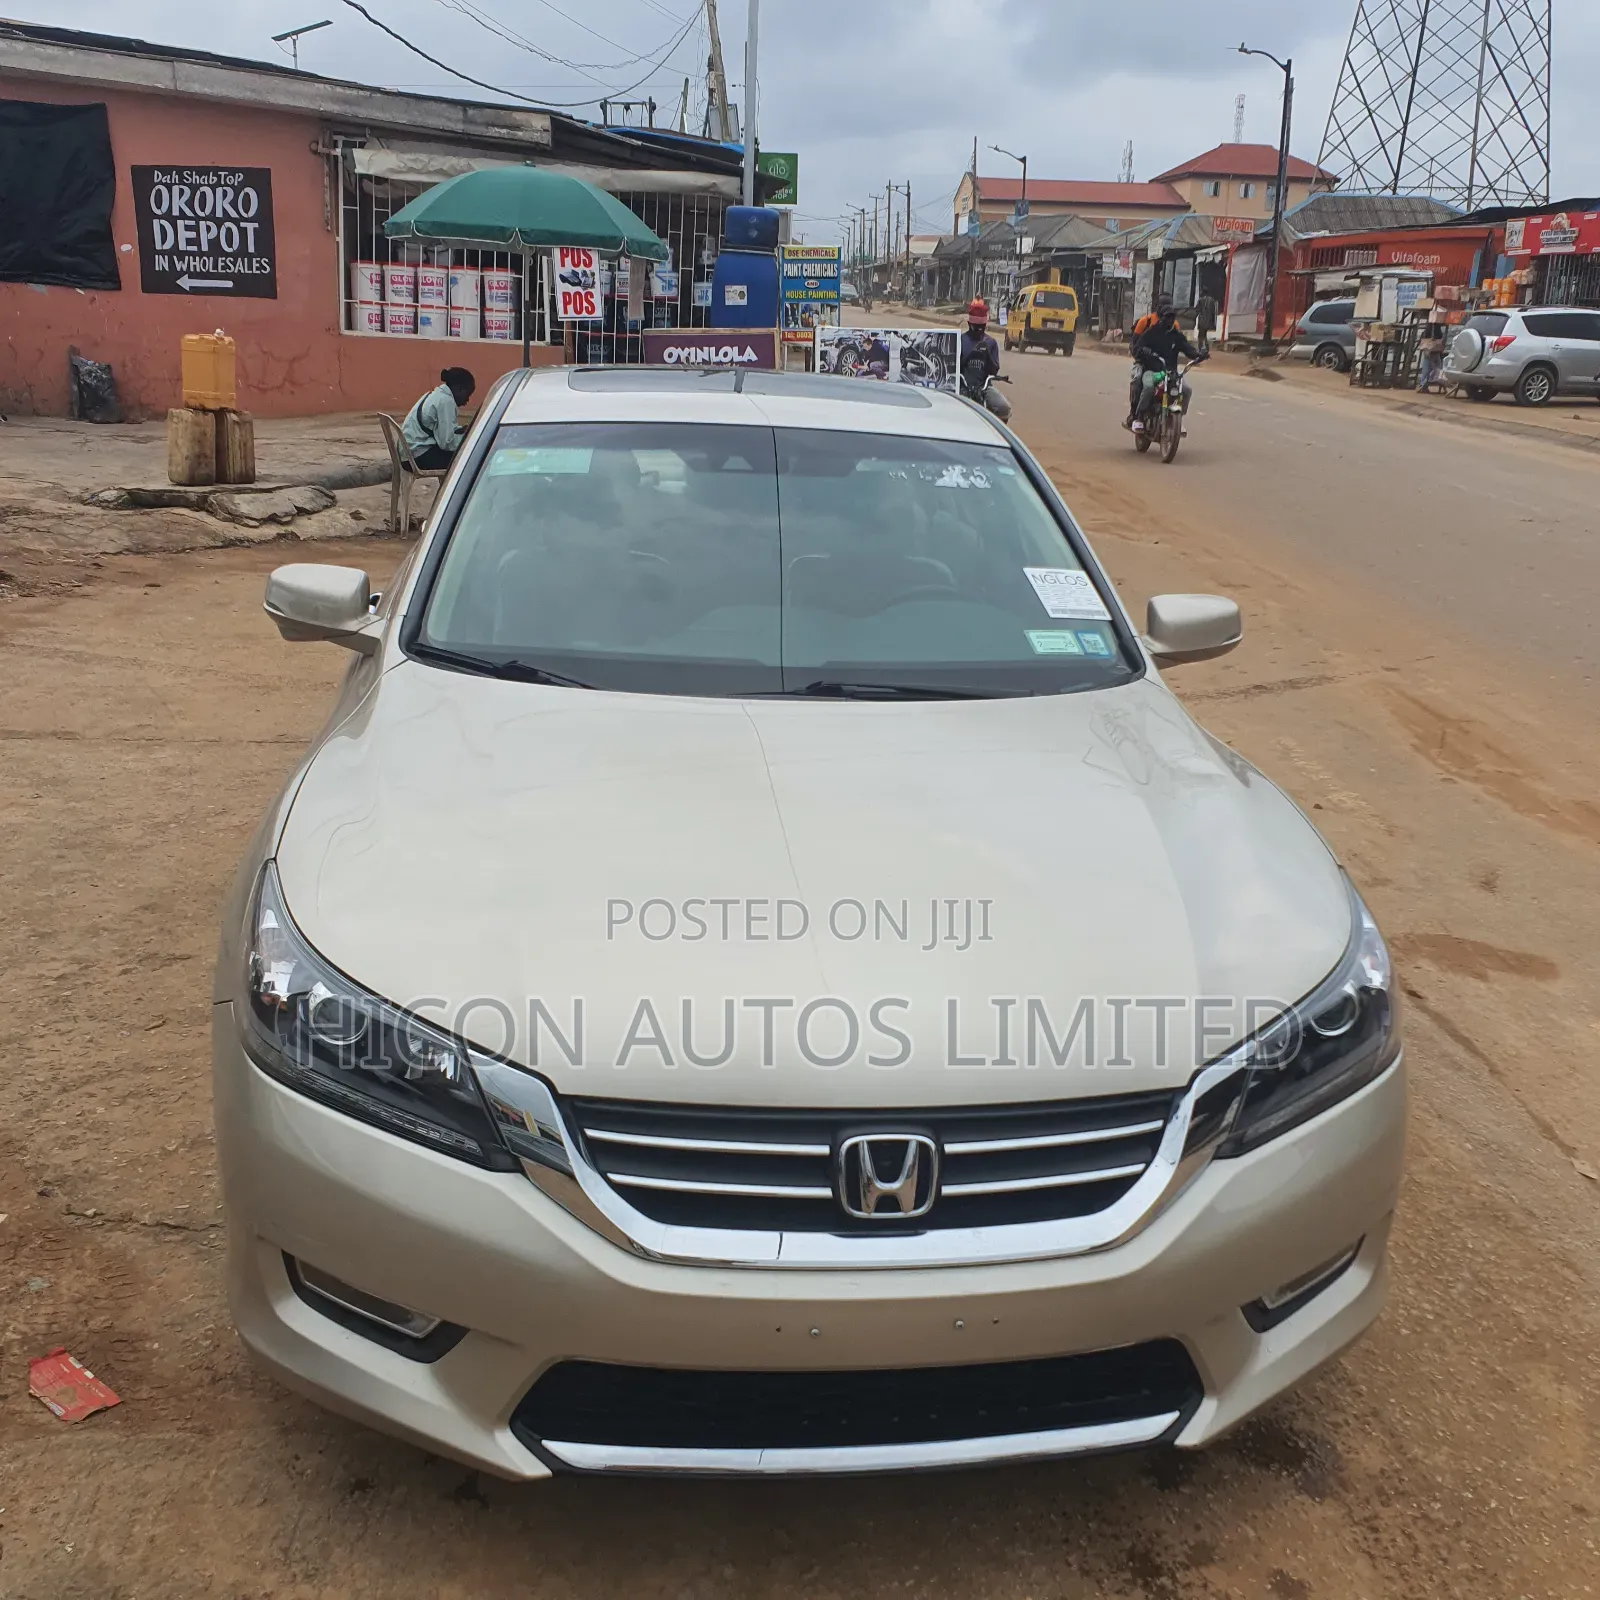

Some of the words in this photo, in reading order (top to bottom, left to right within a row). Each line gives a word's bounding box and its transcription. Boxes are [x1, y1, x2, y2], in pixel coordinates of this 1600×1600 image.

[154, 170, 179, 183] Dah
[150, 184, 258, 218] ORORO
[1215, 217, 1252, 231] Vitafoam
[153, 219, 259, 253] DEPOT
[560, 247, 592, 269] POS
[801, 249, 835, 257] CHEMICALS
[1391, 251, 1440, 265] Vitafoam
[155, 254, 169, 271] IN
[173, 255, 270, 274] WHOLESALES
[783, 263, 801, 277] PAINT
[802, 263, 838, 277] CHEMICALS
[786, 290, 806, 298] HOUSE
[808, 290, 838, 298] PAINTING
[562, 291, 595, 315] POS
[663, 345, 758, 364] OYINLOLA
[1031, 573, 1088, 587] NGLOS
